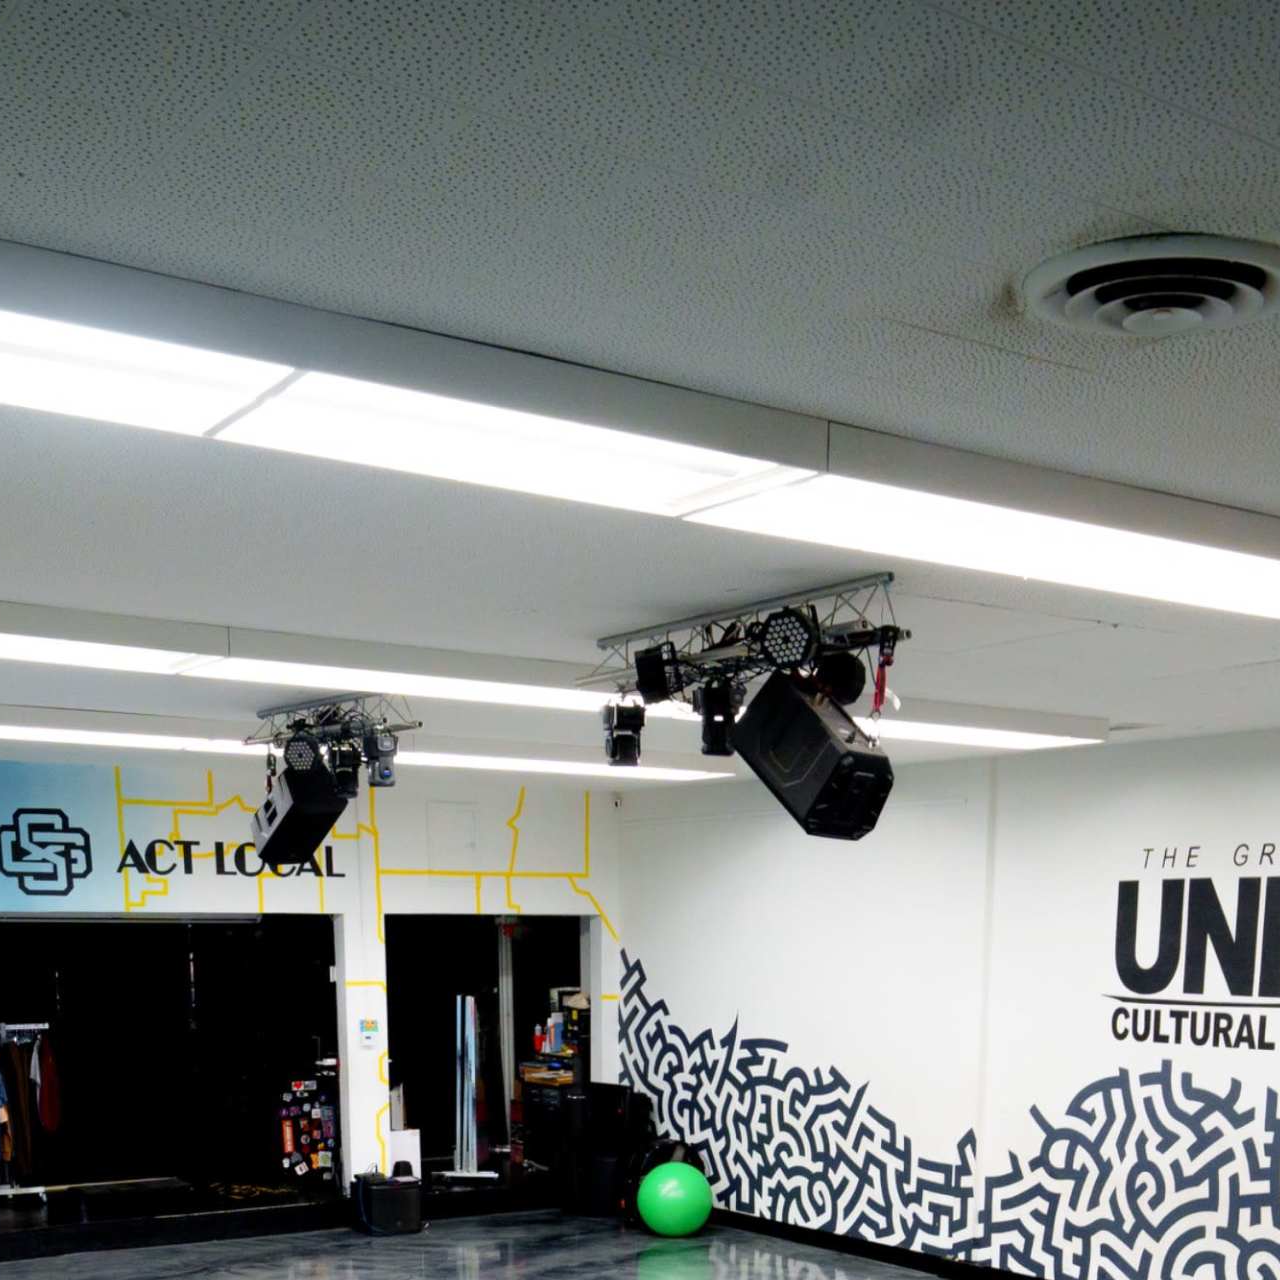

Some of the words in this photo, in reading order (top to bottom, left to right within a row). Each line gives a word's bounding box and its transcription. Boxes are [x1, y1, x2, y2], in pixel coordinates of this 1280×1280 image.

[116, 839, 200, 876] ACT
[1142, 845, 1201, 870] THE
[1111, 1006, 1275, 1050] CULTURAL
